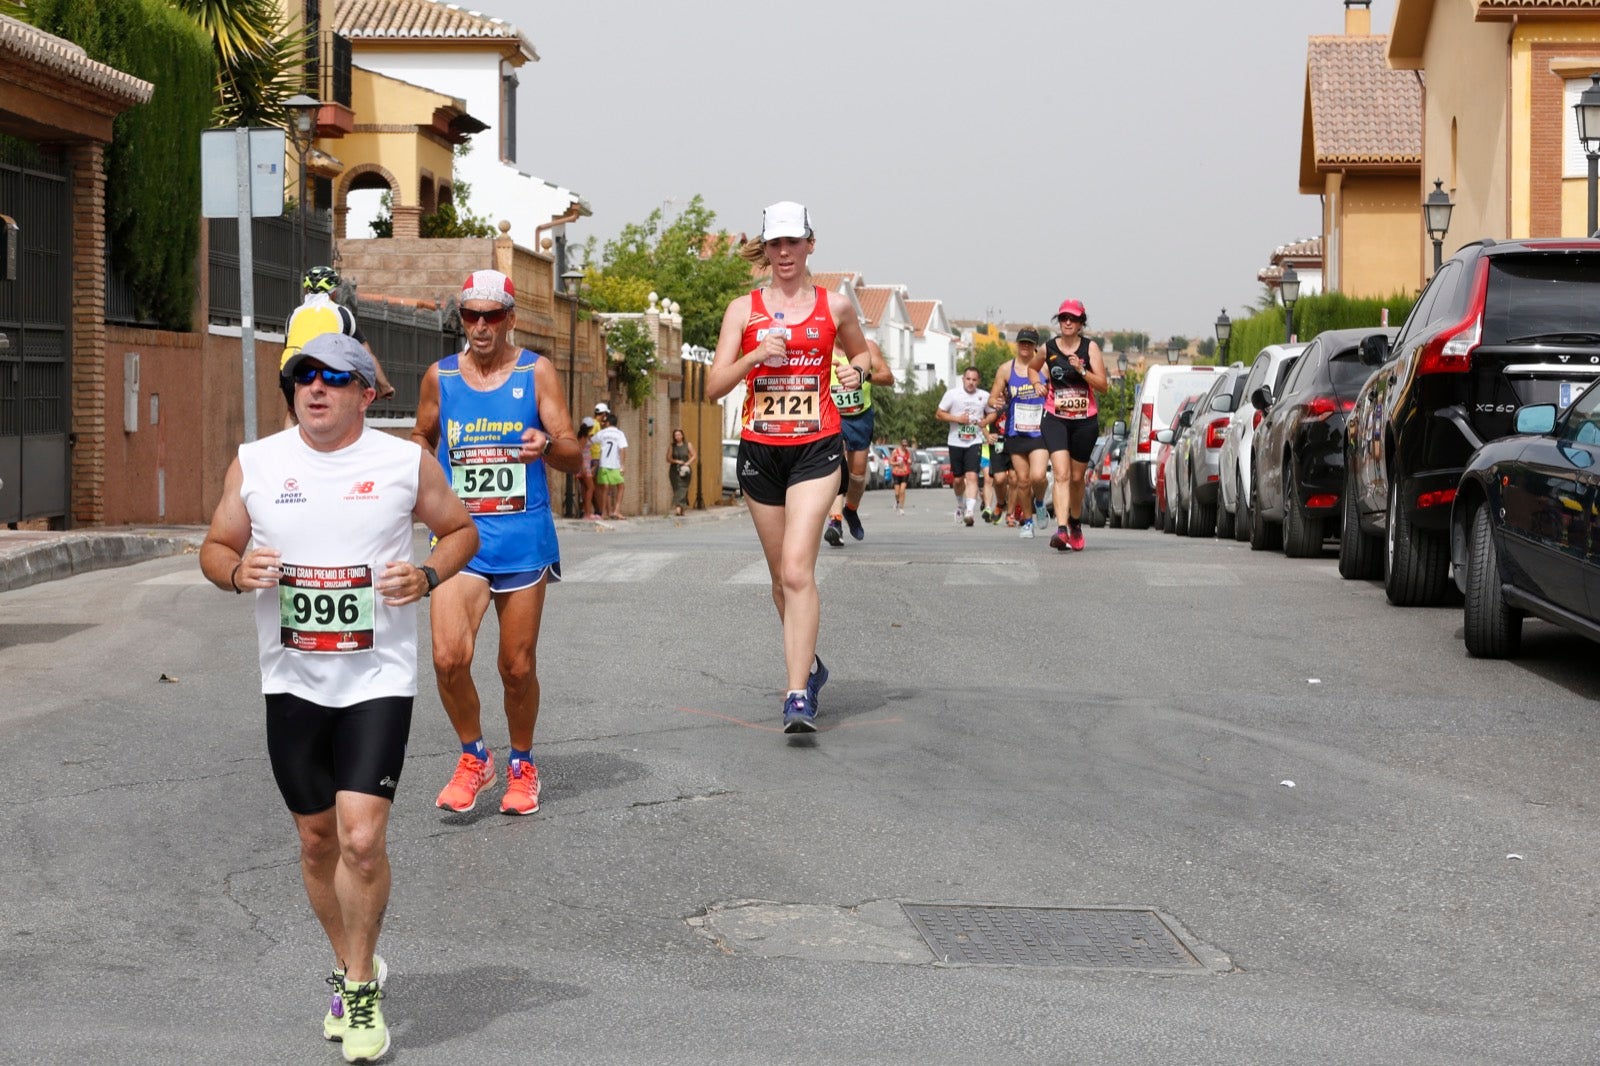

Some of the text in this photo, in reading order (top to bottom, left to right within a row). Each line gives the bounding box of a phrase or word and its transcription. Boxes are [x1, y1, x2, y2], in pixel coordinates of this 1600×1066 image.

[781, 355, 824, 366] salud
[767, 377, 779, 385] GRAN
[763, 395, 813, 415] 2121
[836, 391, 860, 406] 315
[1060, 398, 1088, 409] 2038
[465, 418, 524, 435] olimpo
[960, 425, 975, 434] 409
[463, 435, 501, 443] deportes
[465, 449, 477, 458] GRAN
[477, 448, 497, 457] PREMIO
[606, 441, 614, 458] 7
[463, 467, 514, 493] 520
[296, 567, 313, 578] GRAN
[313, 568, 337, 579] PREMIO
[338, 568, 346, 579] DE
[346, 566, 366, 578] FONDO
[292, 592, 359, 625] 996
